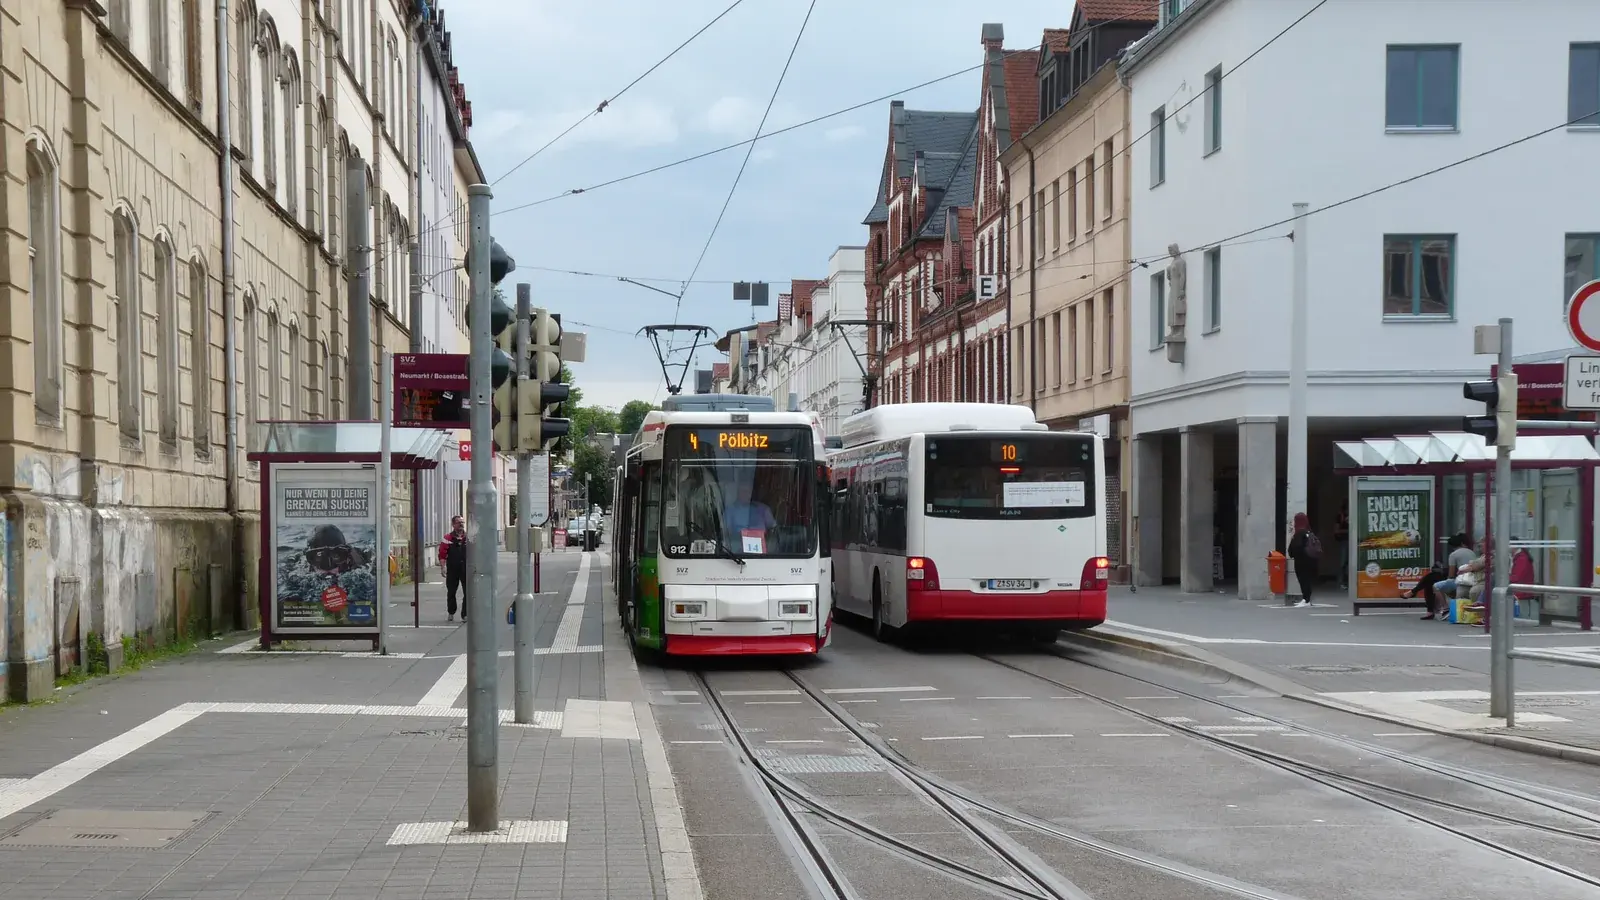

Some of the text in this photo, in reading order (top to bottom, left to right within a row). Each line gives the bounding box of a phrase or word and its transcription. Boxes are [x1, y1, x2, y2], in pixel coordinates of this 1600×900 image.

[981, 277, 992, 296] E
[400, 355, 416, 363] SVZ
[690, 432, 768, 450] 4 Pölbitz
[1002, 444, 1016, 460] 10
[285, 489, 368, 499] NUR WENN DU DEINE
[286, 499, 368, 511] GRENZEN SUCHST,
[1367, 494, 1419, 512] ENDLICH
[1368, 511, 1419, 532] RASEN
[670, 545, 686, 554] 912
[1367, 547, 1421, 560] IM INTERNET!
[1397, 567, 1420, 577] 400
